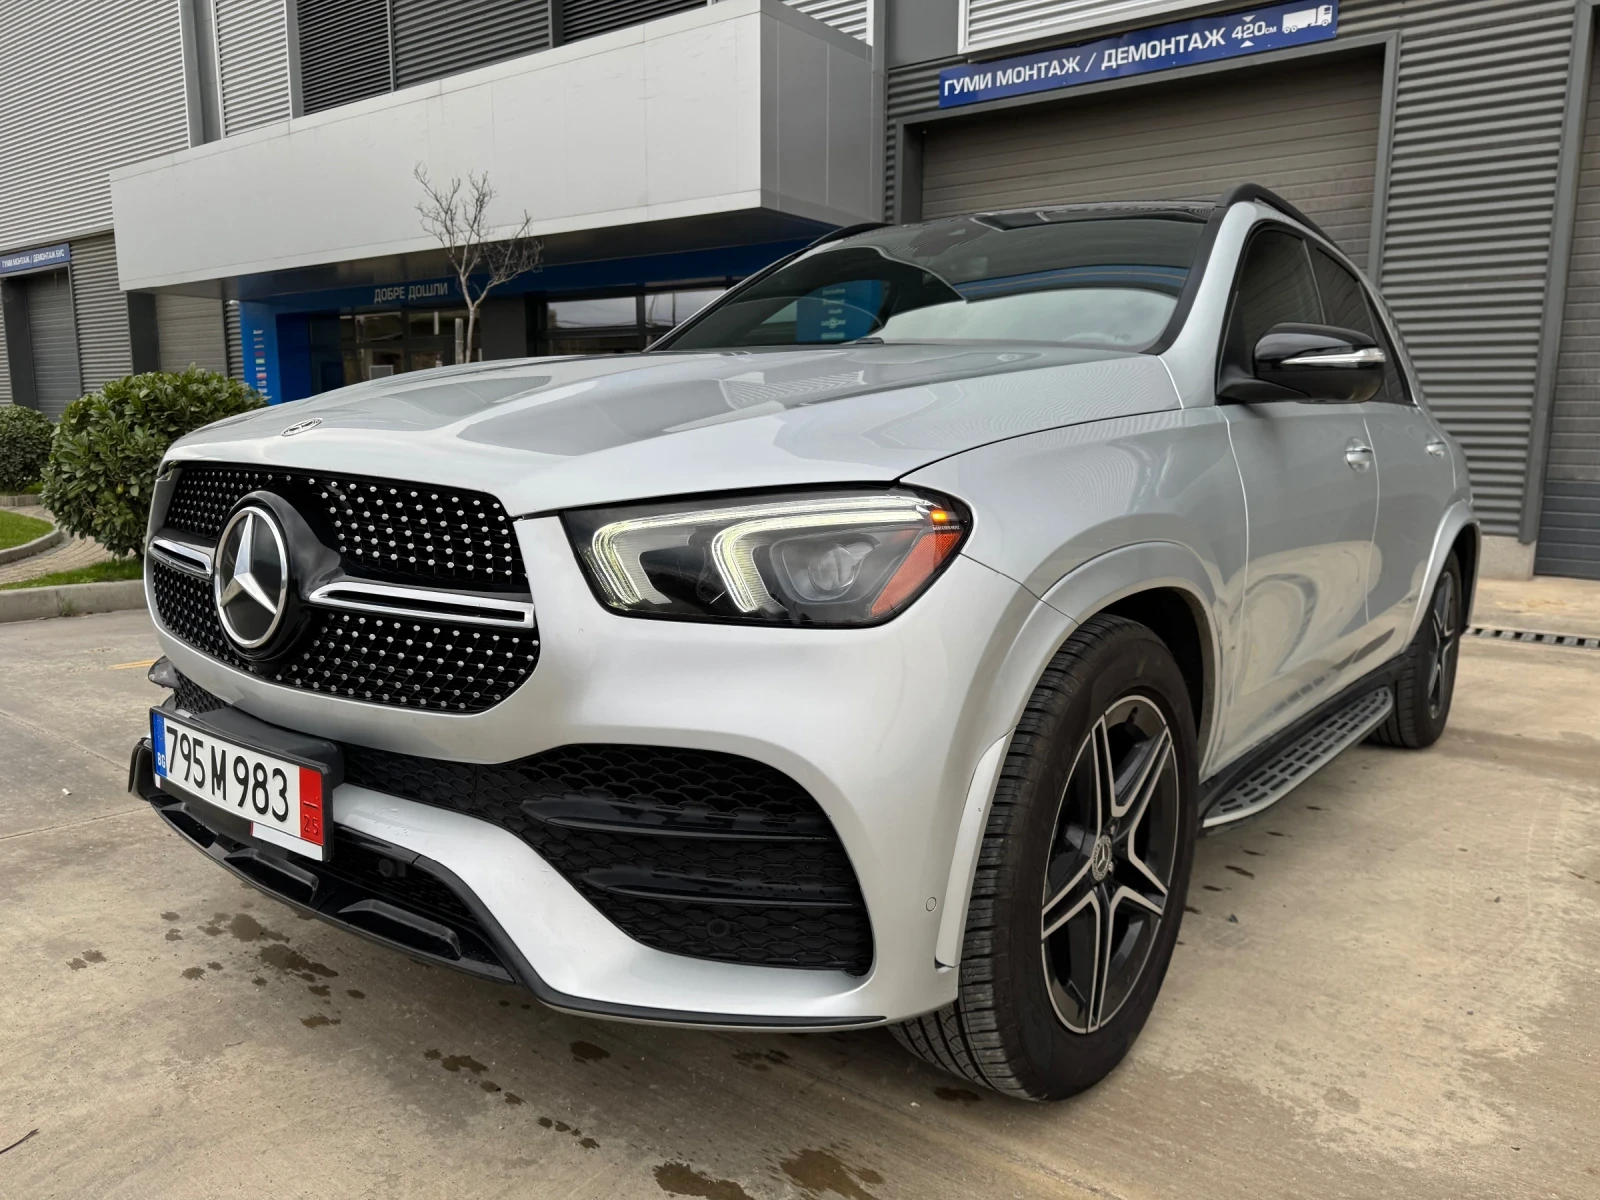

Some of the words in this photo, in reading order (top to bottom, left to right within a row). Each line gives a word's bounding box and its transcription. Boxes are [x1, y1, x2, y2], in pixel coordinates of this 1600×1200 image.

[944, 72, 993, 97] ГУМИ
[996, 55, 1081, 87] МОНТАЖ
[1084, 52, 1097, 73] /
[1101, 27, 1226, 71] ДЕМОНТАЖ
[374, 286, 405, 304] ДОБРЕ
[408, 282, 448, 300] ДОШЛИ
[157, 752, 166, 768] BG
[166, 725, 206, 789] 795
[233, 755, 289, 823] 983
[303, 813, 319, 836] 25
